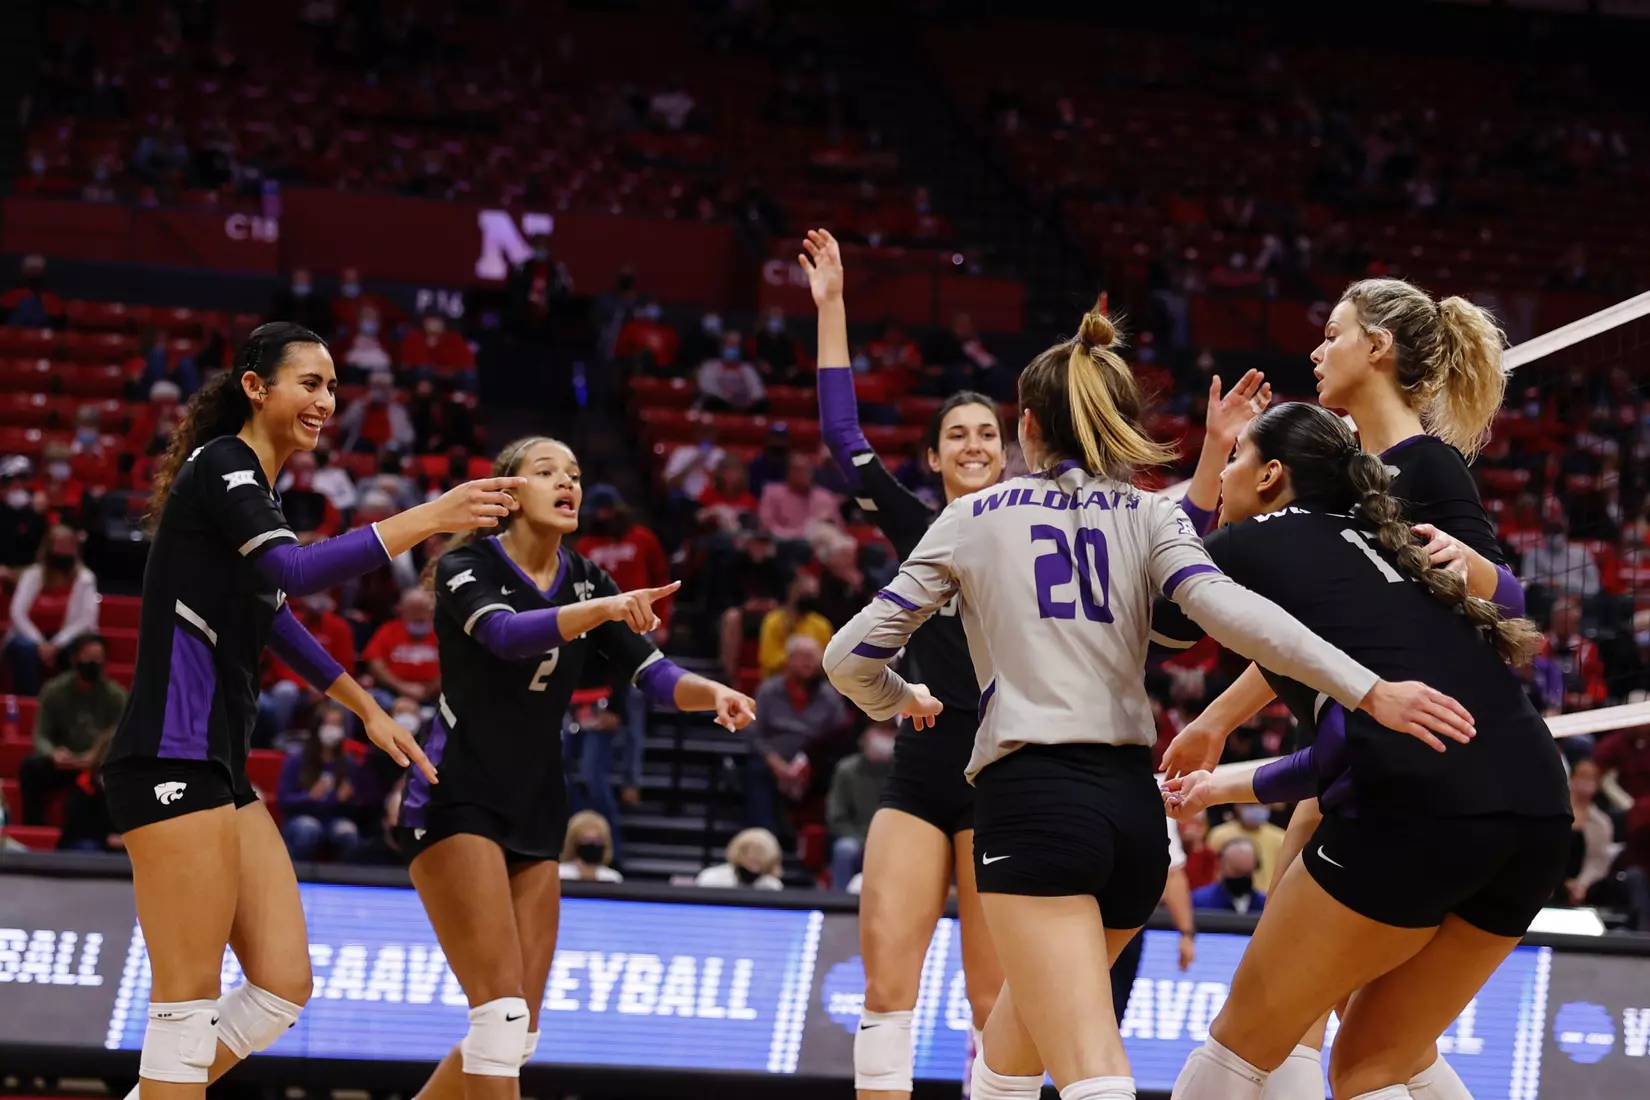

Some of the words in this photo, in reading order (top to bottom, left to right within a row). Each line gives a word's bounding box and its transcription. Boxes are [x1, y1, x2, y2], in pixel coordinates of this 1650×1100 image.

[973, 487, 1142, 517] WILDCATS
[1030, 524, 1115, 624] 20
[528, 646, 560, 692] 2
